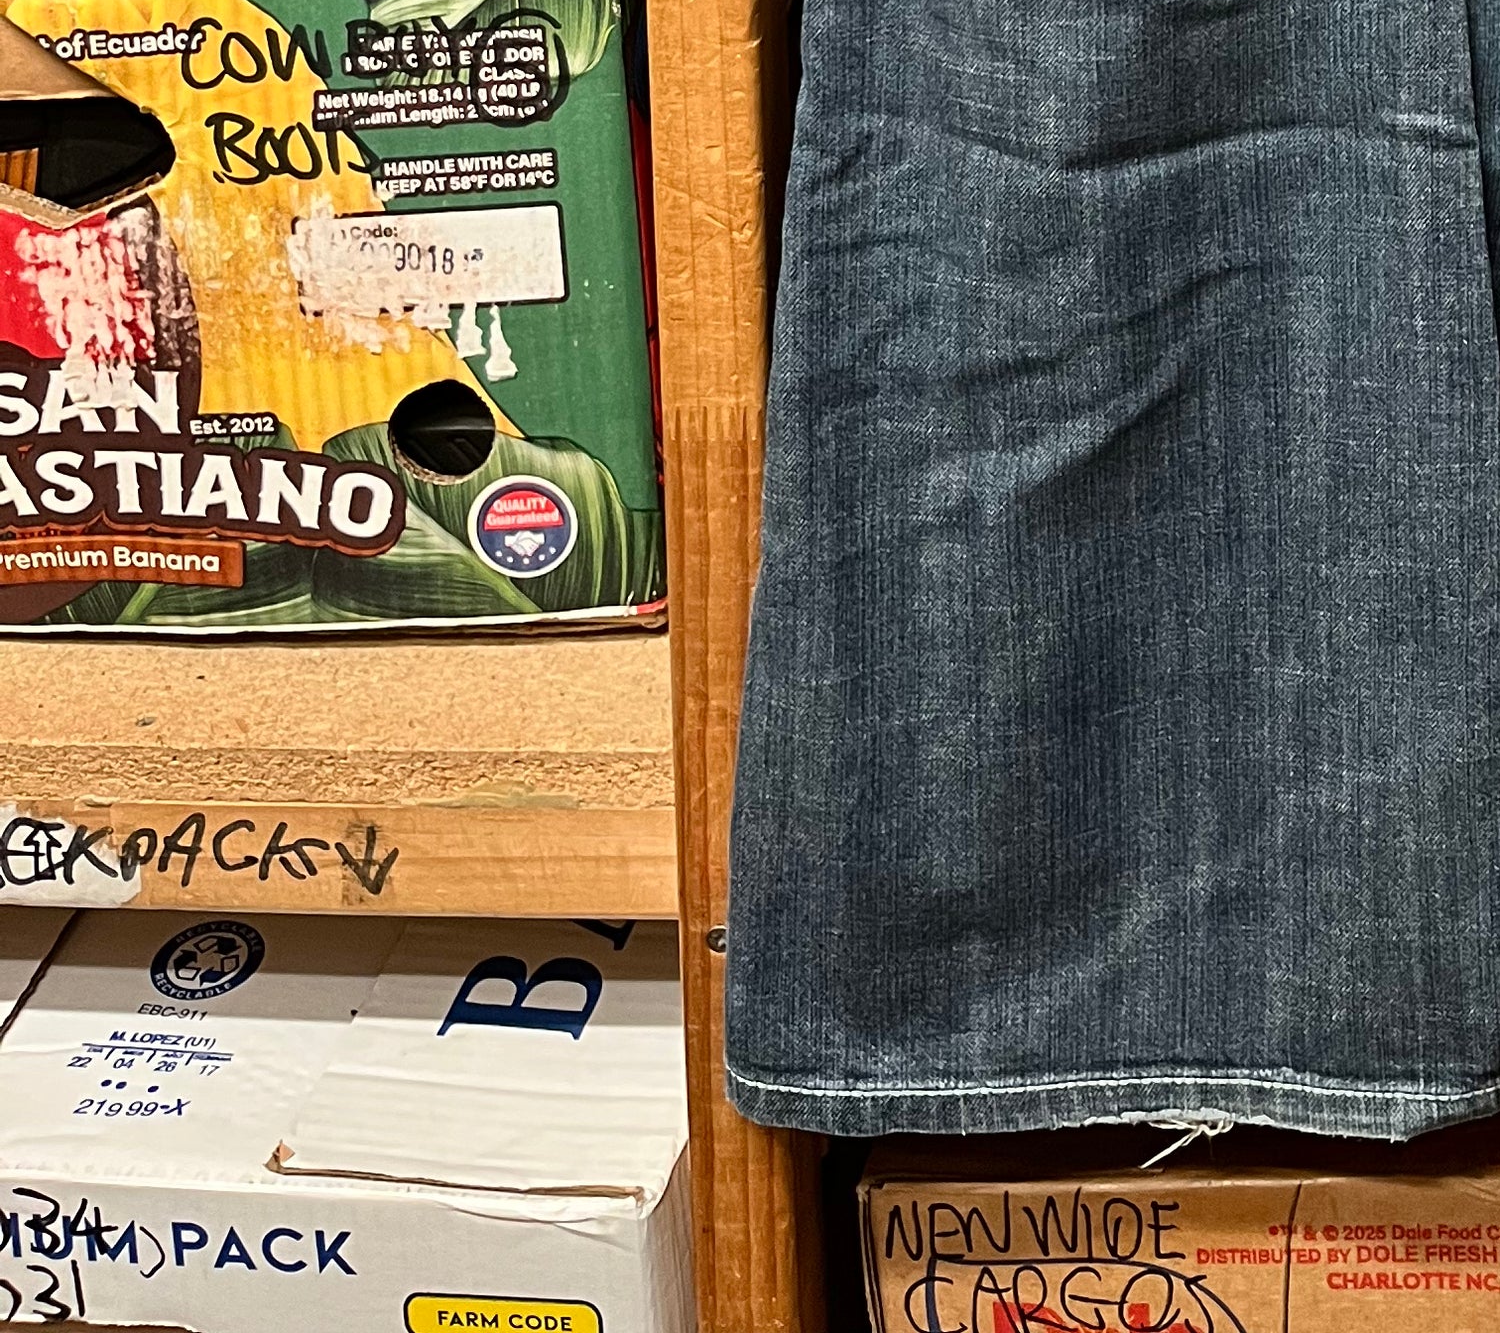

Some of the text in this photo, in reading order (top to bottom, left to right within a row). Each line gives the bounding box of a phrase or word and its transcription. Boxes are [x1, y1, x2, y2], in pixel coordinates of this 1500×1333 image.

[56, 36, 85, 59] of
[182, 17, 332, 89] COW
[318, 90, 418, 109] Net Weight:
[384, 152, 553, 177] HANDLE WITH CARE
[376, 173, 518, 195] KEEP AT OR
[190, 416, 275, 436] Est. 2012
[493, 497, 548, 513] QUALITY
[113, 546, 220, 572] Banana
[131, 1032, 184, 1045] LOPEZ
[67, 1056, 220, 1076] 22 04 17
[1023, 1187, 1187, 1262] WIDE
[1343, 1225, 1386, 1242] 2025
[1437, 1223, 1483, 1241] Food
[171, 1221, 358, 1276] PACK
[1327, 1247, 1352, 1265] BY
[1356, 1244, 1419, 1264] DOLE
[1425, 1244, 1498, 1263] FRESH
[1326, 1272, 1461, 1291] CHARLOTTE
[437, 1309, 573, 1333] FARM CODE
